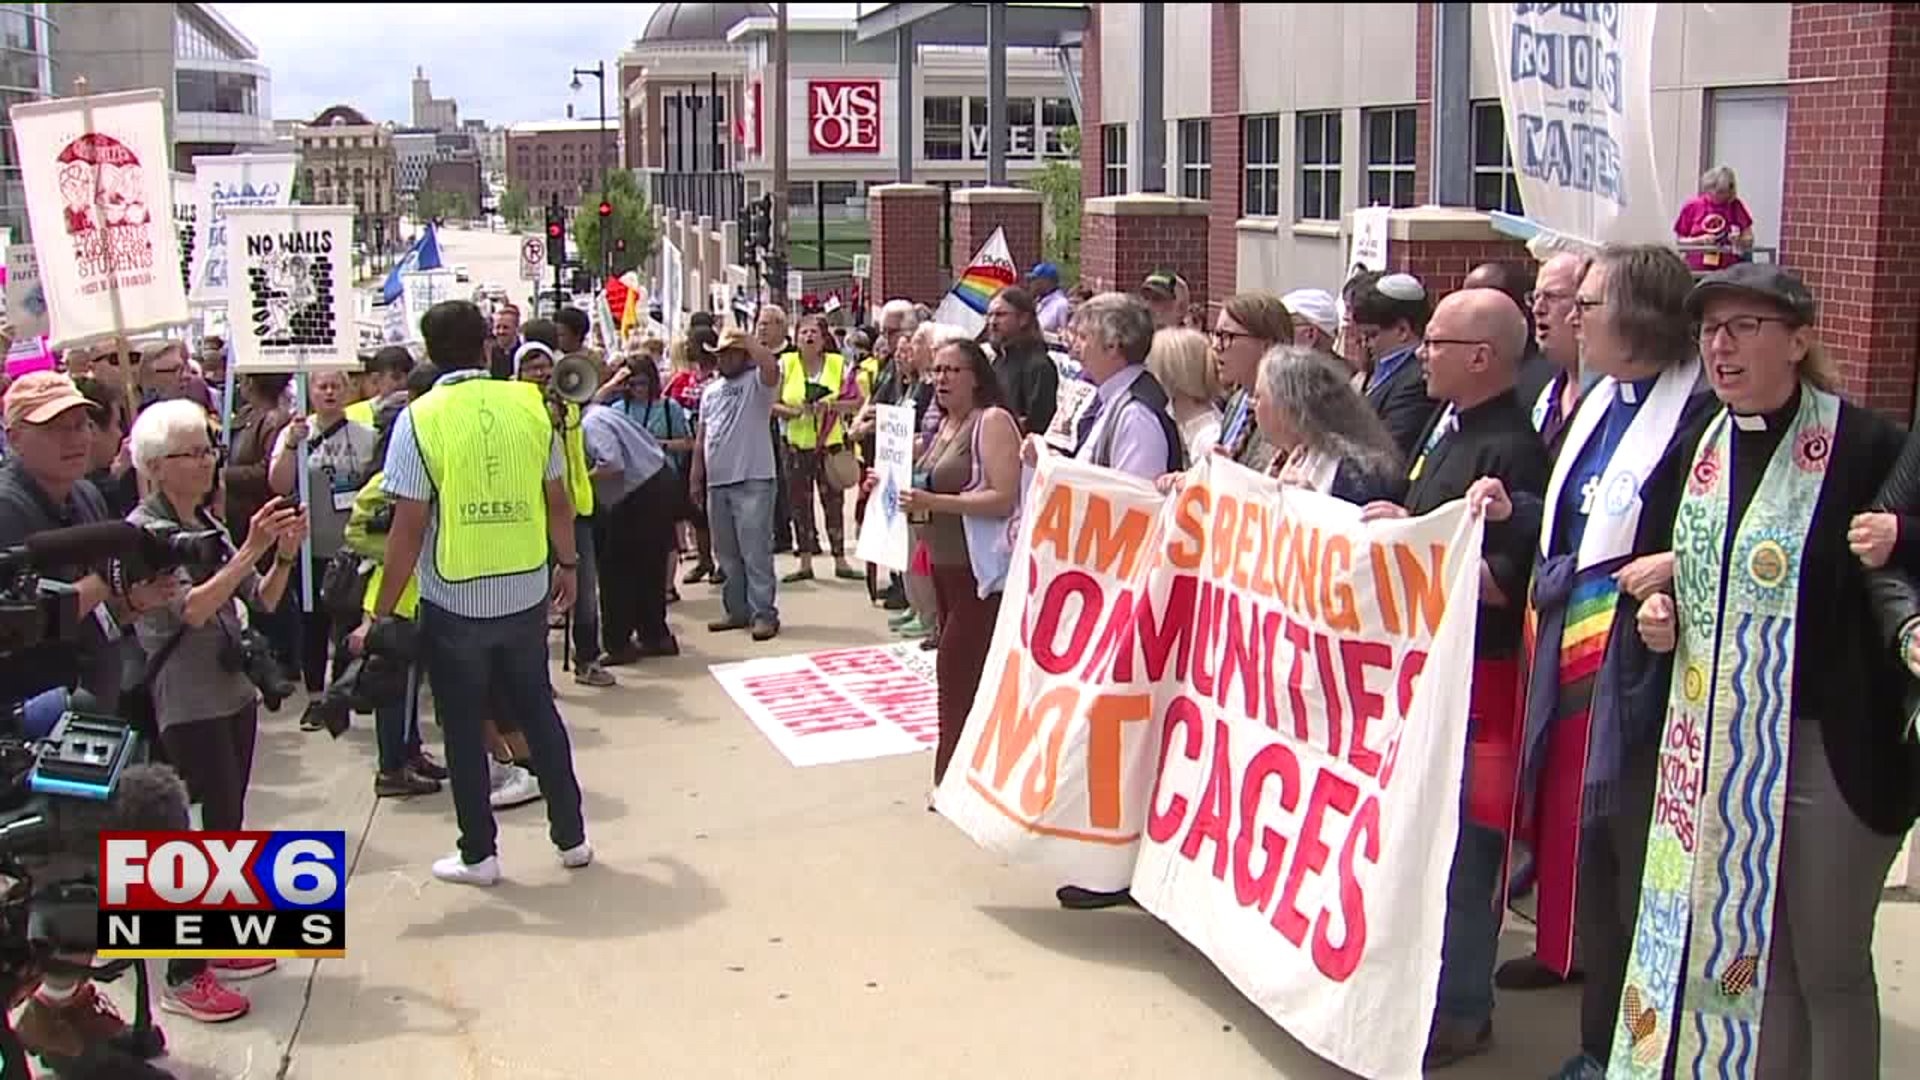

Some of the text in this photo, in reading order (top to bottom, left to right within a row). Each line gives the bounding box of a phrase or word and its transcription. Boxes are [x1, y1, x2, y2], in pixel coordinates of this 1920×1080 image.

[247, 234, 273, 256] NO
[279, 230, 333, 254] WALLS
[459, 502, 513, 516] VOCES
[1211, 494, 1360, 632] BELONG
[1370, 542, 1447, 637] IN
[972, 651, 1152, 830] NOT
[1147, 697, 1381, 983] CAGES
